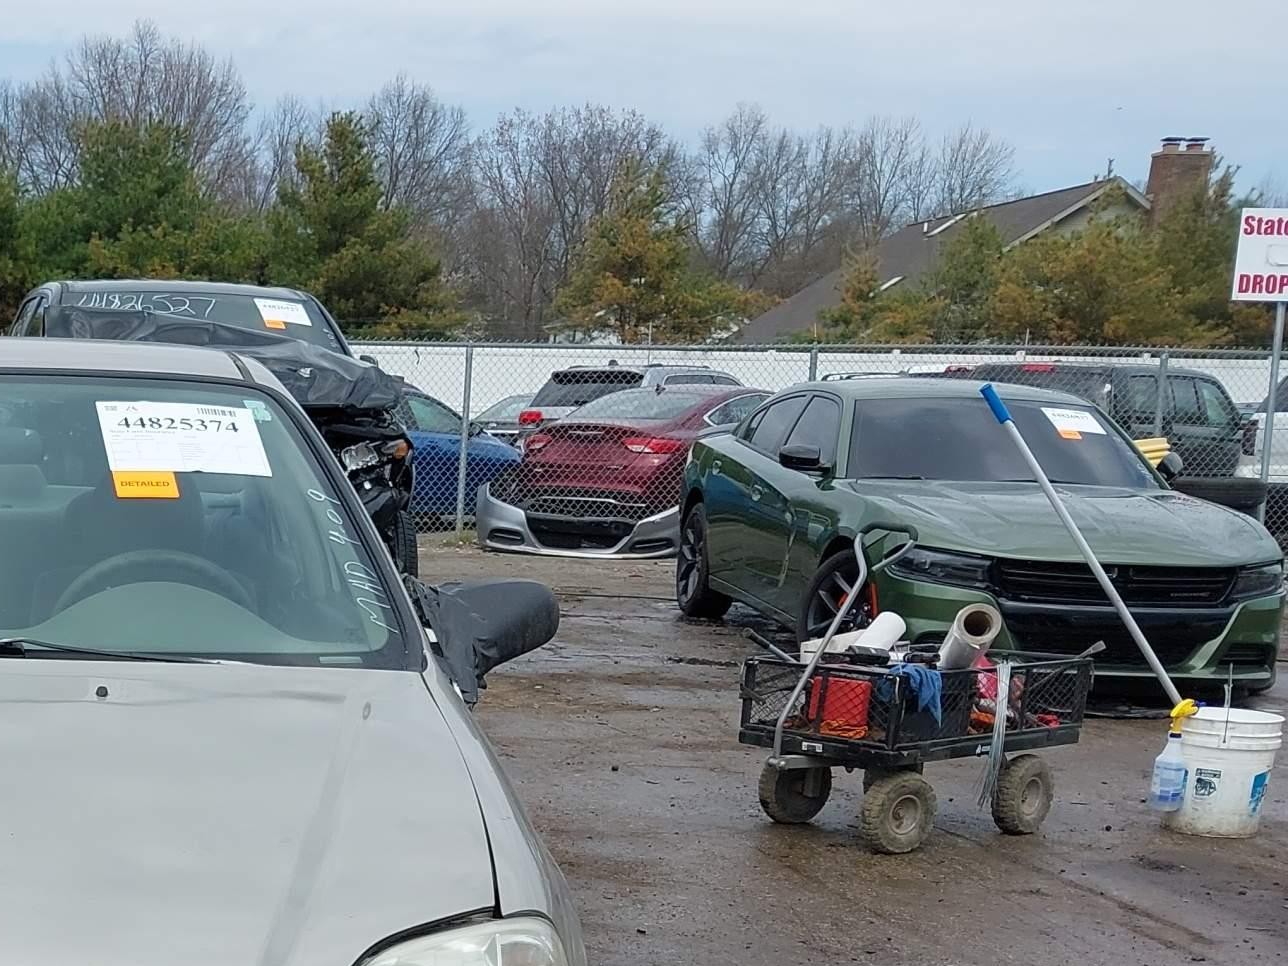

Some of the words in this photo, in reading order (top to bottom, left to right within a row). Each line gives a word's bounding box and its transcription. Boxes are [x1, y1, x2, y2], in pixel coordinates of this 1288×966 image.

[1238, 274, 1288, 294] DROP
[117, 416, 239, 433] 44825374
[120, 480, 170, 488] DETAILED
